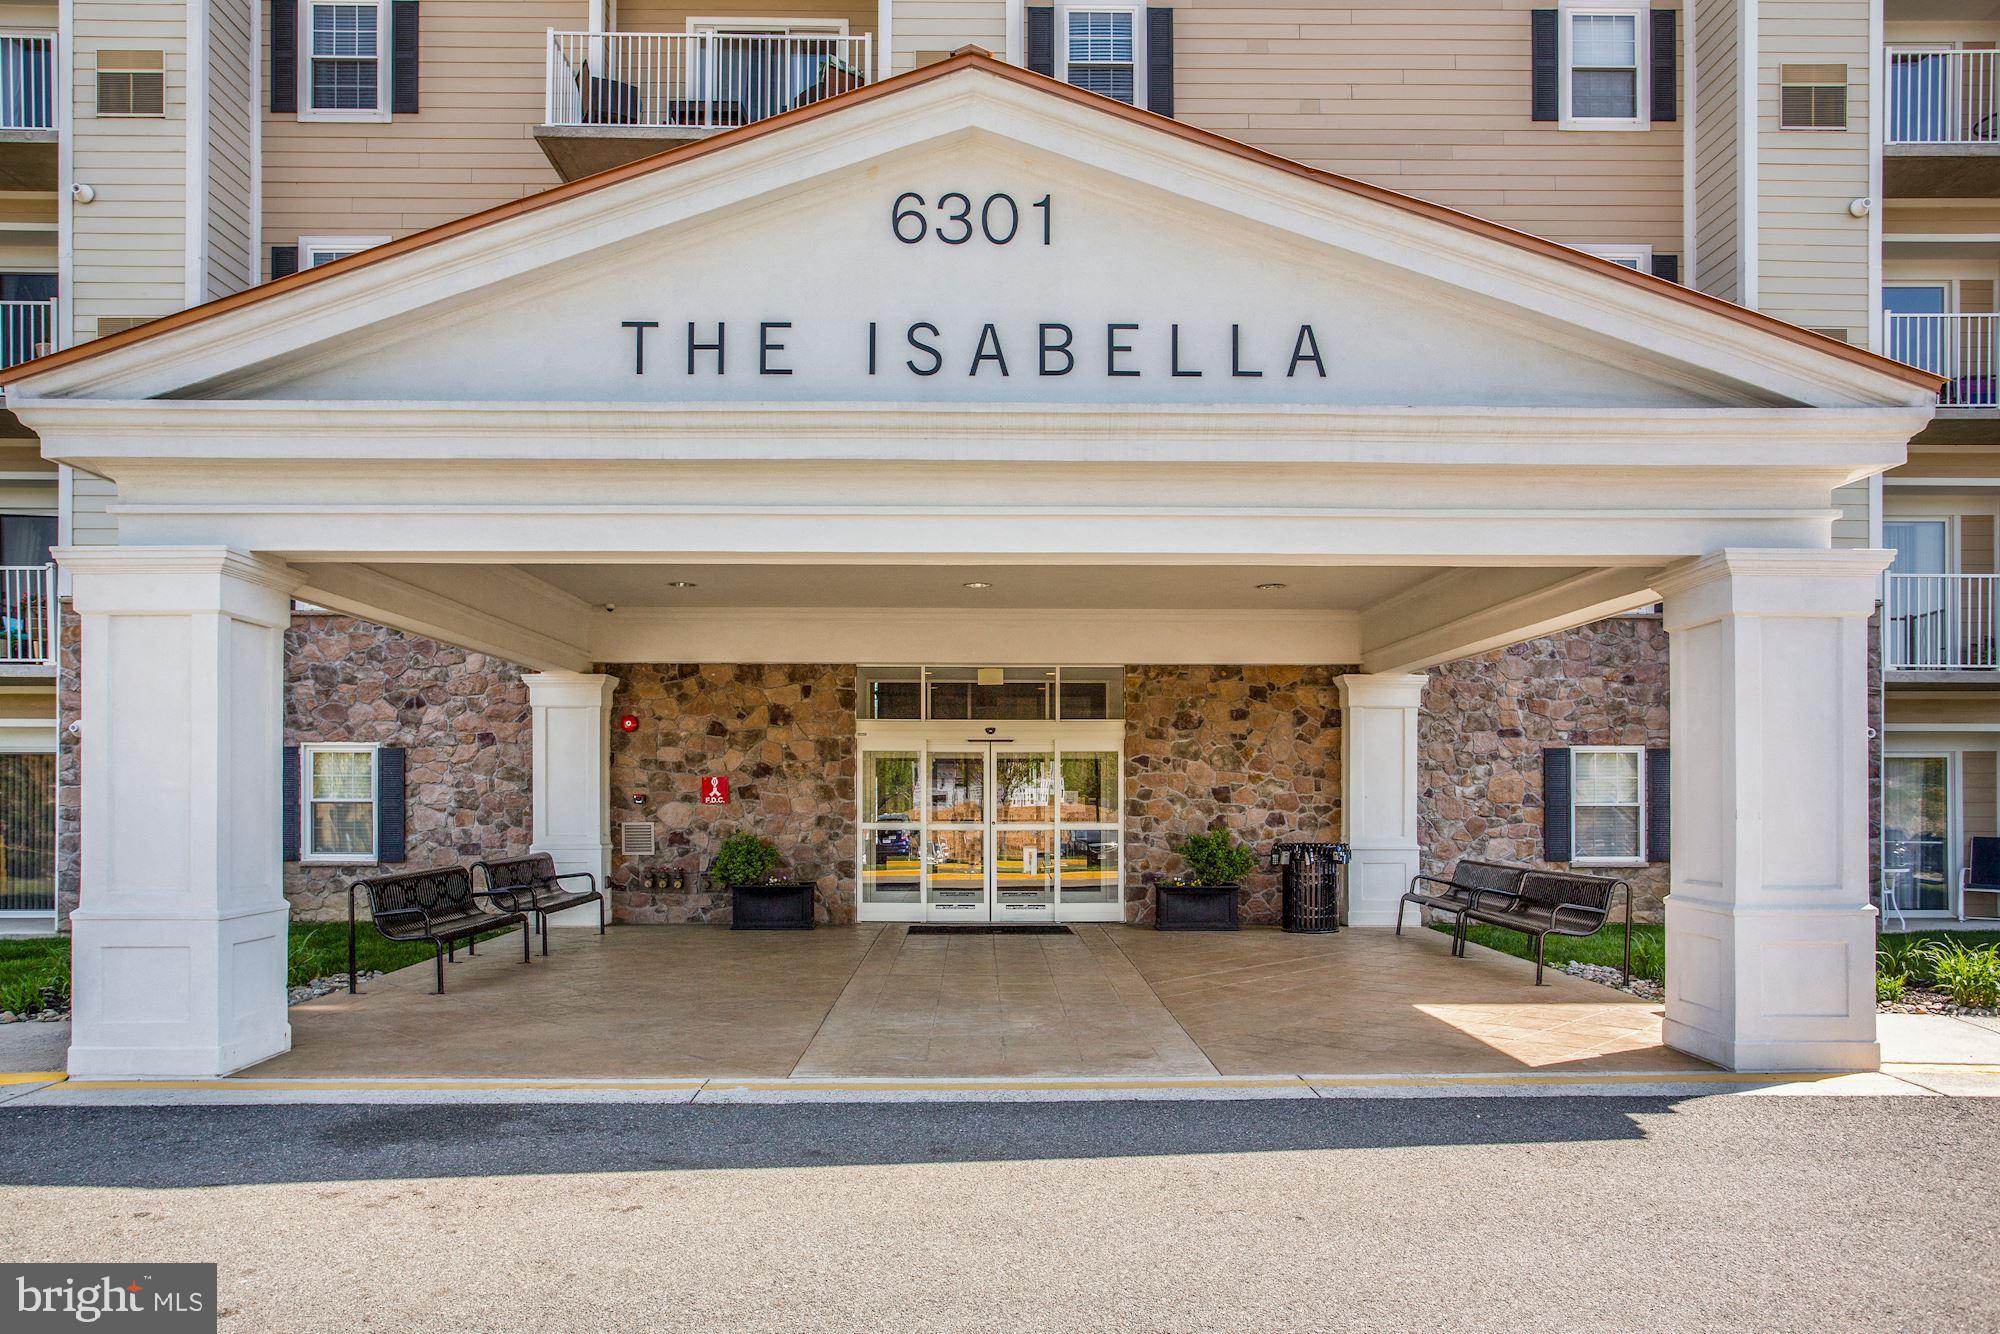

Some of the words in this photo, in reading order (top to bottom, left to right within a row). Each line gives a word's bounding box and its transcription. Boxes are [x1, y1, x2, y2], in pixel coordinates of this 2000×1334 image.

[891, 192, 1051, 246] 6301
[621, 321, 793, 375] THE
[868, 322, 1327, 378] ISABELLA
[705, 796, 725, 804] F.D.C.
